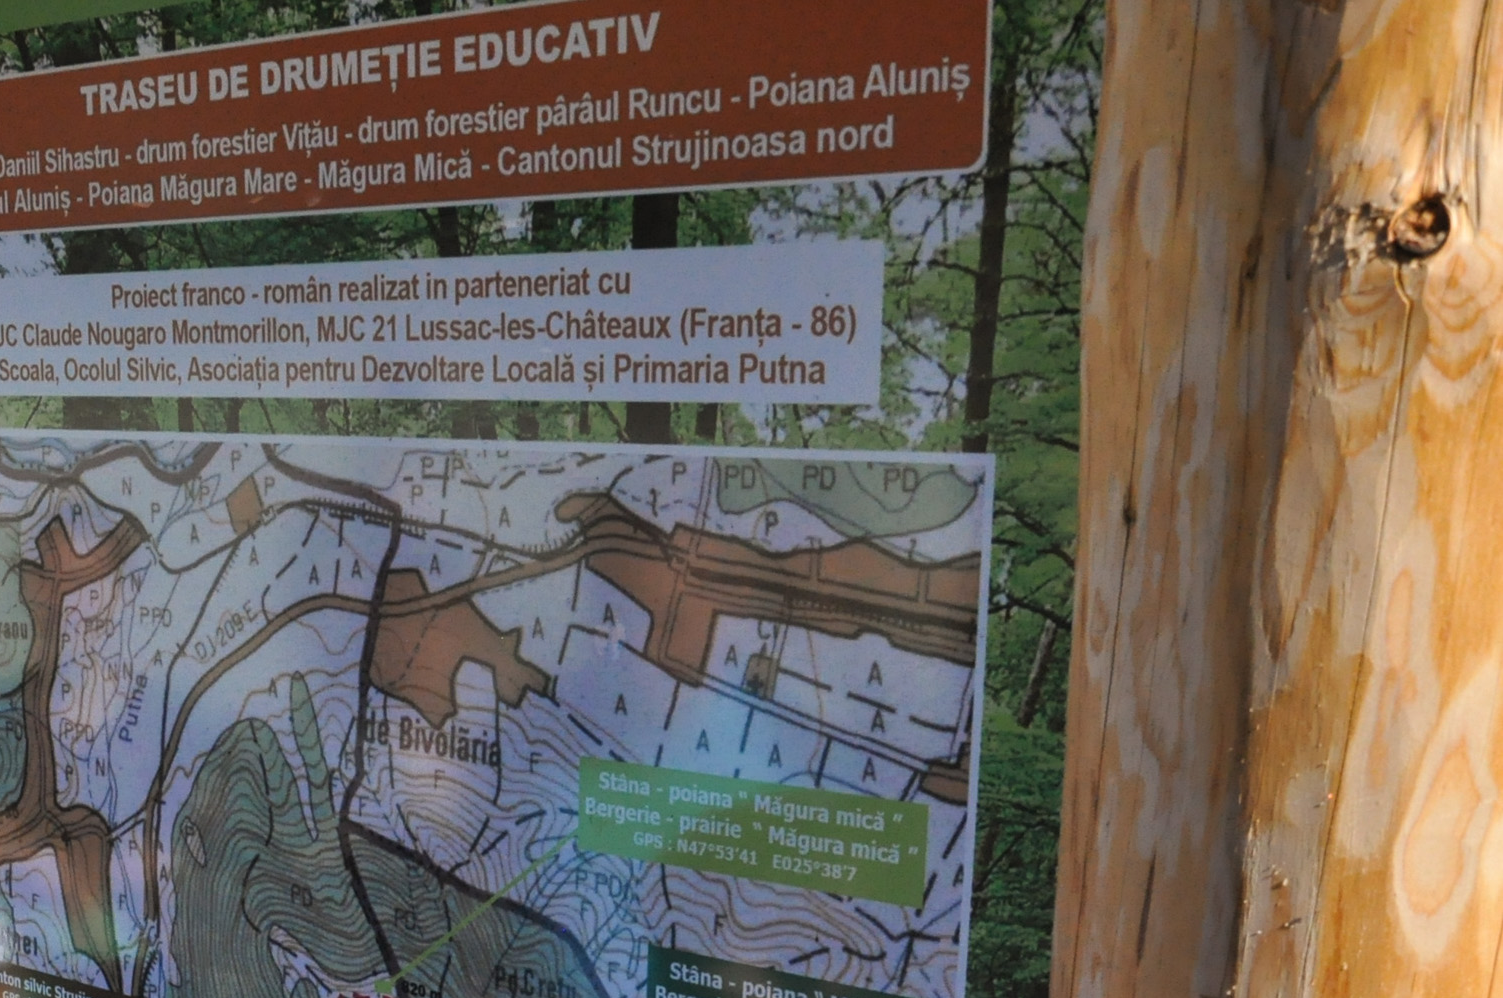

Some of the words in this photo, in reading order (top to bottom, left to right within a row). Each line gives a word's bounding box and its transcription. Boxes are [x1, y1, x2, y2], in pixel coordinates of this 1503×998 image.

[80, 73, 198, 117] TRASEU
[207, 66, 250, 100] DE
[259, 39, 441, 97] DRUMEȚIE
[454, 12, 660, 73] EDUCATIV
[44, 139, 120, 176] Sihastru
[135, 131, 186, 165] drum
[190, 127, 277, 159] forestier
[282, 119, 337, 154] Vițău
[357, 113, 419, 147] drum
[425, 102, 529, 138] forestier
[536, 89, 620, 136] pârâul
[628, 84, 721, 121] Runcu
[748, 71, 855, 110] Poiana
[863, 57, 971, 103] Aluniș
[14, 182, 71, 217] Aluniș
[88, 176, 154, 209] Poiana
[159, 169, 237, 207] Măgura
[243, 167, 297, 197] Mare
[318, 154, 406, 193] Măgura
[414, 151, 473, 182] Mică
[497, 138, 622, 176] Cantonul
[632, 128, 806, 170] Strujinoasa
[816, 115, 895, 151] nord
[111, 282, 177, 312] Proiect
[182, 281, 245, 307] franco
[263, 277, 330, 303] român
[331, 276, 420, 302] realizat
[426, 273, 448, 298] in
[454, 269, 590, 305] parteneriat
[598, 273, 631, 296] cu
[22, 321, 83, 347] Claude
[87, 321, 167, 351] Nougaro
[172, 319, 311, 349] Montmorillon,
[316, 316, 365, 344] MJC
[372, 316, 398, 341] 21
[406, 309, 672, 341] Lussac-les-Châteaux
[680, 306, 782, 348] (Franța
[811, 304, 858, 339] 86)
[64, 356, 122, 383] Ocolul
[127, 356, 182, 385] Silvic,
[187, 355, 279, 390] Asociația
[285, 357, 355, 390] pentru
[361, 356, 484, 384] Dezvoltare
[492, 353, 575, 384] Locală
[583, 354, 605, 393] și
[613, 353, 729, 385] Primaria
[738, 353, 826, 385] Putna
[598, 771, 651, 797] Stâna
[668, 785, 733, 809] poiana
[754, 789, 830, 824] Măgura
[836, 806, 886, 832] mică
[585, 796, 661, 827] Bergerie
[679, 815, 742, 839] prairie
[768, 825, 845, 856] Măgura
[850, 839, 901, 864] mică
[633, 832, 663, 851] GPS
[24, 976, 53, 997] silvic
[670, 962, 723, 990] Stâna
